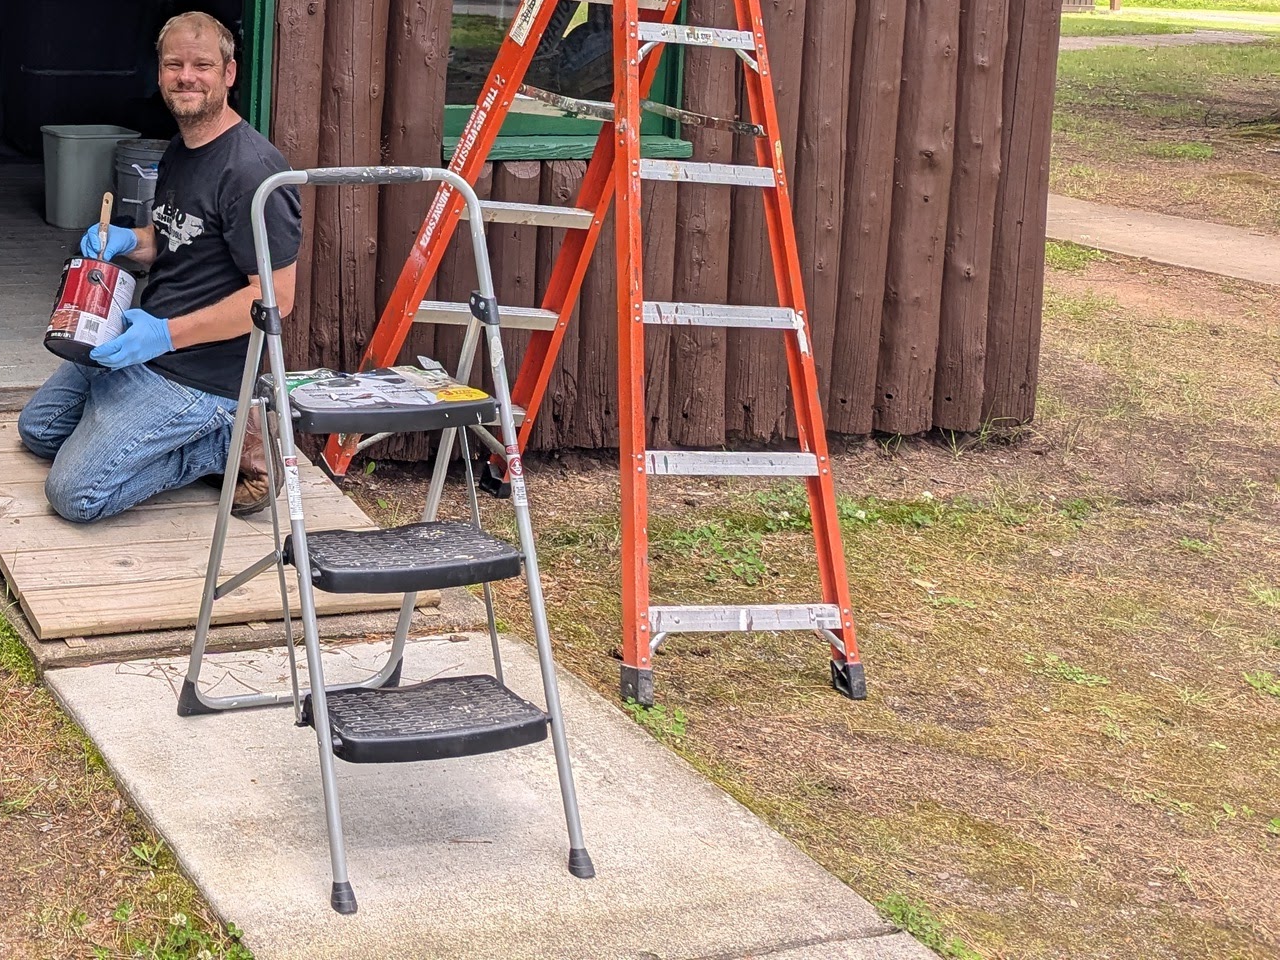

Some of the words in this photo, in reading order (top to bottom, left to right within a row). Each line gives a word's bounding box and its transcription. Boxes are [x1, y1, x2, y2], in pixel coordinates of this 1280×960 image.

[482, 87, 499, 111] THE
[455, 109, 487, 175] UNIVERSITY
[420, 188, 450, 249] MINNESOTA
